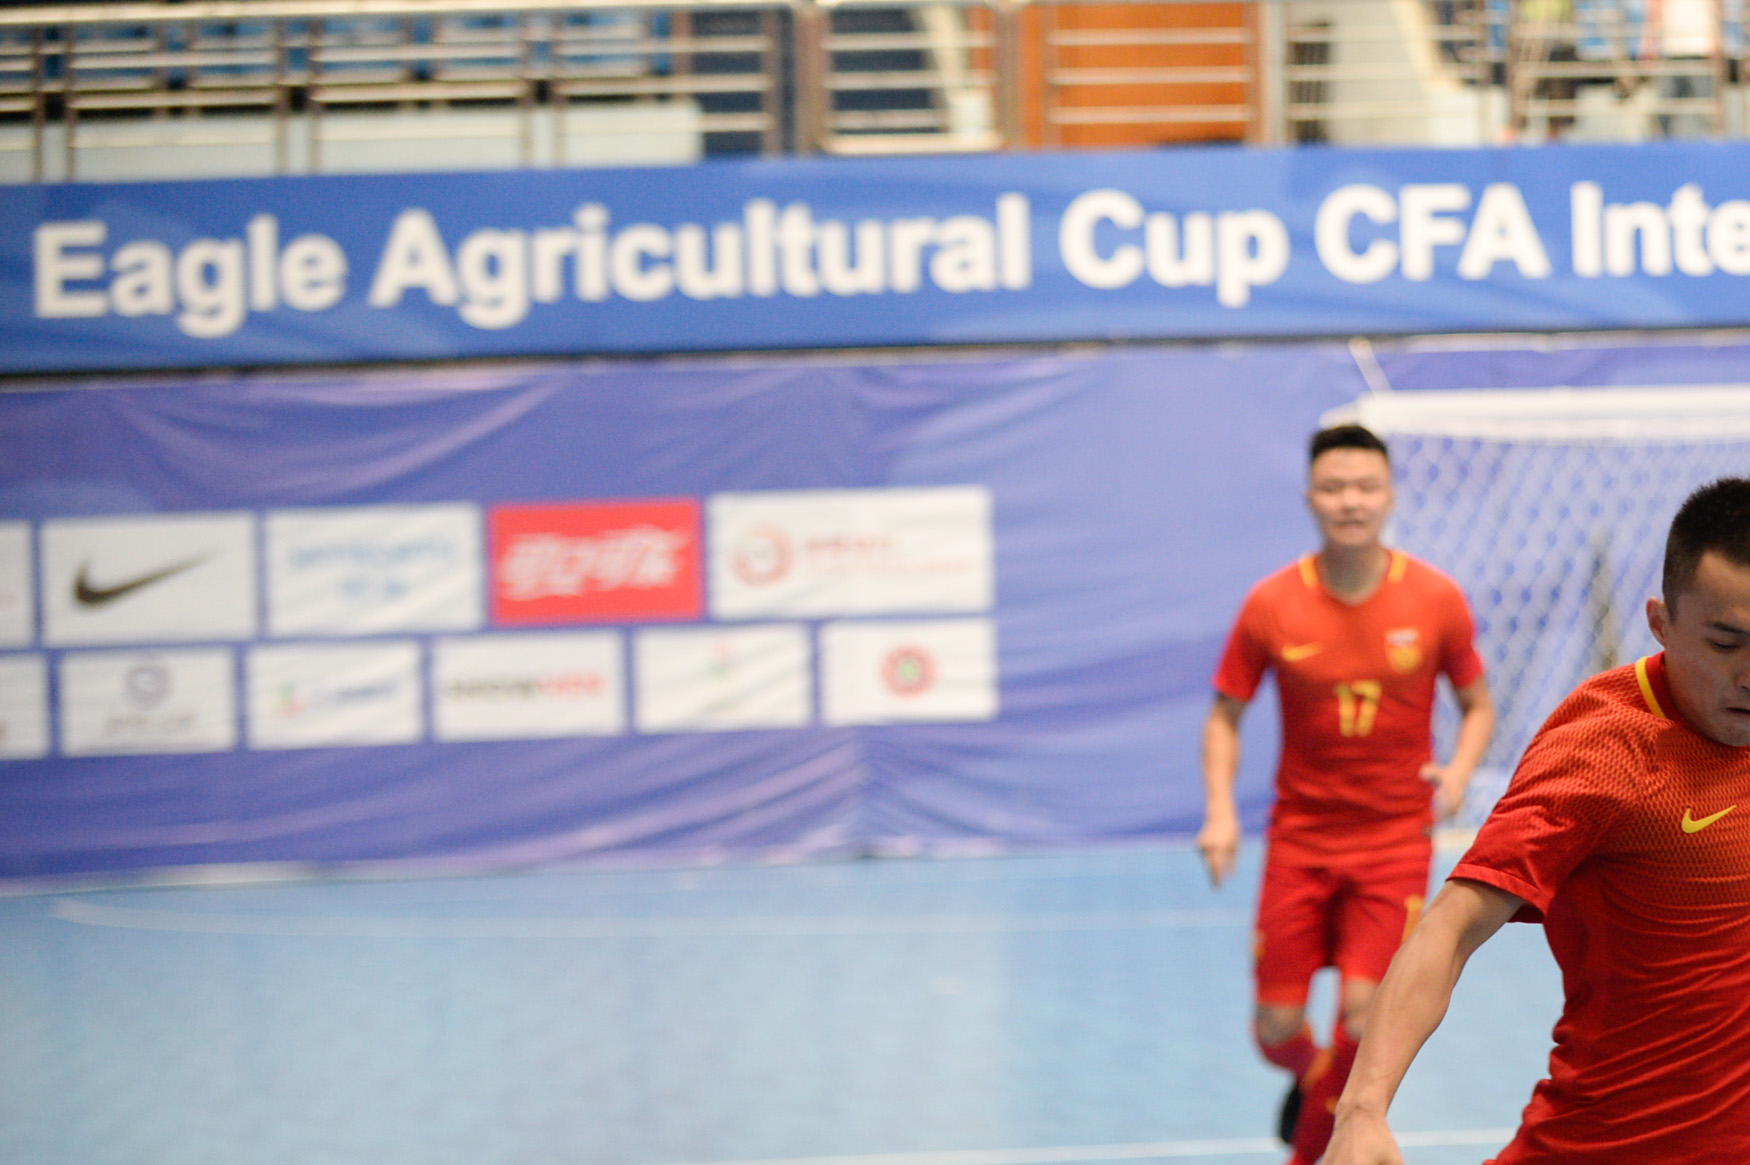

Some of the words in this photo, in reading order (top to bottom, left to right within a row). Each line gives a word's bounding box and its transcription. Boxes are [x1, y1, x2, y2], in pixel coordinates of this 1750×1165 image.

[33, 214, 347, 340] Eagle
[367, 190, 1034, 332] Agricultural
[1055, 186, 1292, 311] Cup
[1309, 180, 1554, 288] CFA
[1334, 679, 1382, 737] 17
